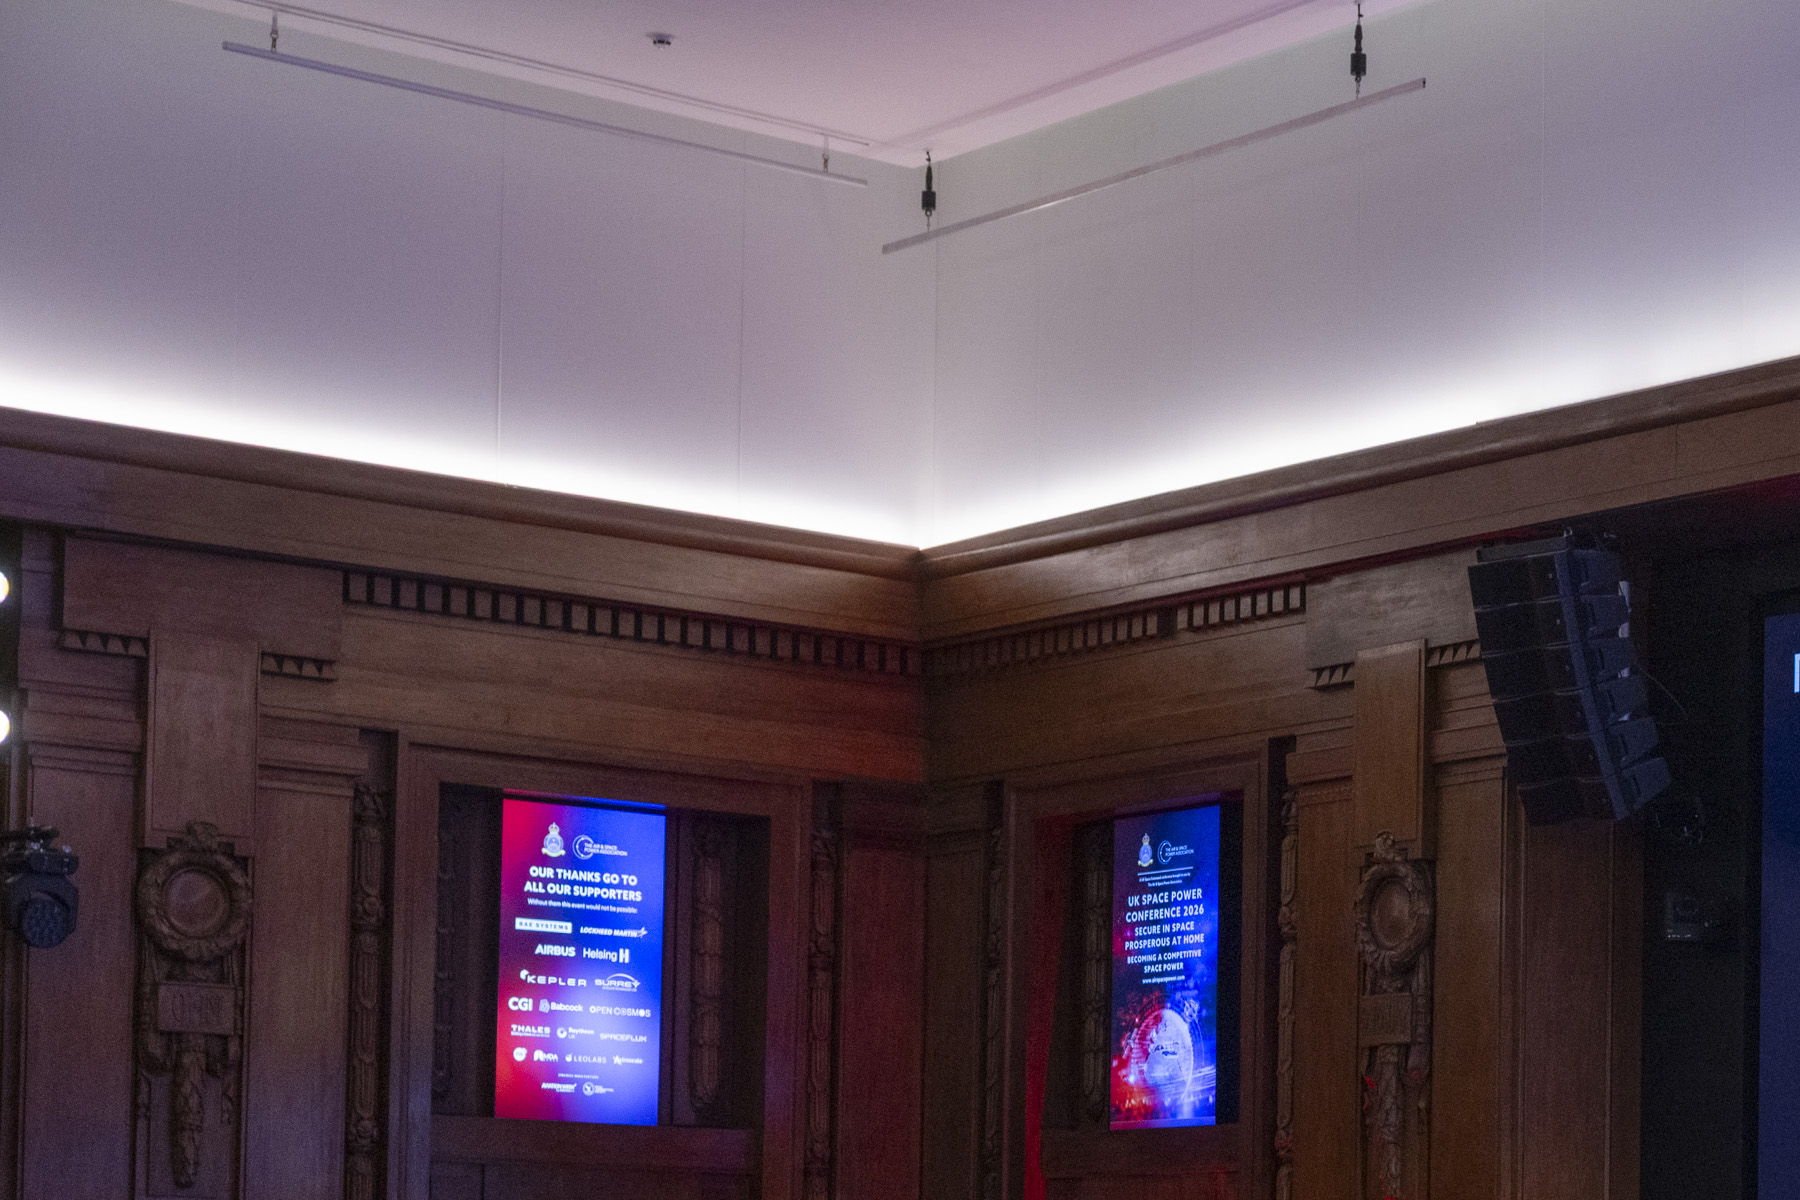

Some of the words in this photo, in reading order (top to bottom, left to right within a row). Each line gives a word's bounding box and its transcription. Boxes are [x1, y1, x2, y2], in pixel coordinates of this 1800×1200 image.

[529, 866, 554, 878] OUR
[556, 868, 601, 883] THANKS
[603, 872, 619, 885] GO
[622, 875, 638, 886] TO
[524, 881, 546, 893] ALL
[547, 882, 572, 896] OUR
[574, 886, 642, 902] SUPPORTERS
[1128, 896, 1140, 907] UK
[1142, 892, 1168, 905] SPACE
[1171, 888, 1202, 902] POWER
[1126, 906, 1180, 922] CONFERENCE
[1184, 904, 1204, 916] 2026
[536, 922, 568, 930] SYSTEMS
[580, 926, 612, 936] LOCKHEED
[614, 928, 637, 938] MARTIN
[1135, 924, 1160, 936] SECURE
[1162, 924, 1170, 933] IN
[1172, 921, 1194, 932] SPACE
[1125, 938, 1170, 950] PROSPEROUS
[1172, 936, 1182, 945] AT
[1184, 934, 1204, 944] HOME
[535, 944, 576, 957] AIRBUS
[583, 948, 618, 962] Helsing
[1127, 953, 1156, 964] BECOMING
[1158, 952, 1162, 960] A
[1164, 949, 1202, 960] COMPETITIVE
[1144, 964, 1162, 973] SPACE
[1163, 962, 1184, 972] POWER
[527, 975, 586, 987] KEPLER
[595, 979, 640, 988] SURREY
[508, 996, 533, 1012] CGI
[551, 1002, 584, 1012] Babcock
[590, 1005, 612, 1015] OPEN
[511, 1024, 551, 1034] THALES
[574, 1055, 606, 1064] LEOLABS
